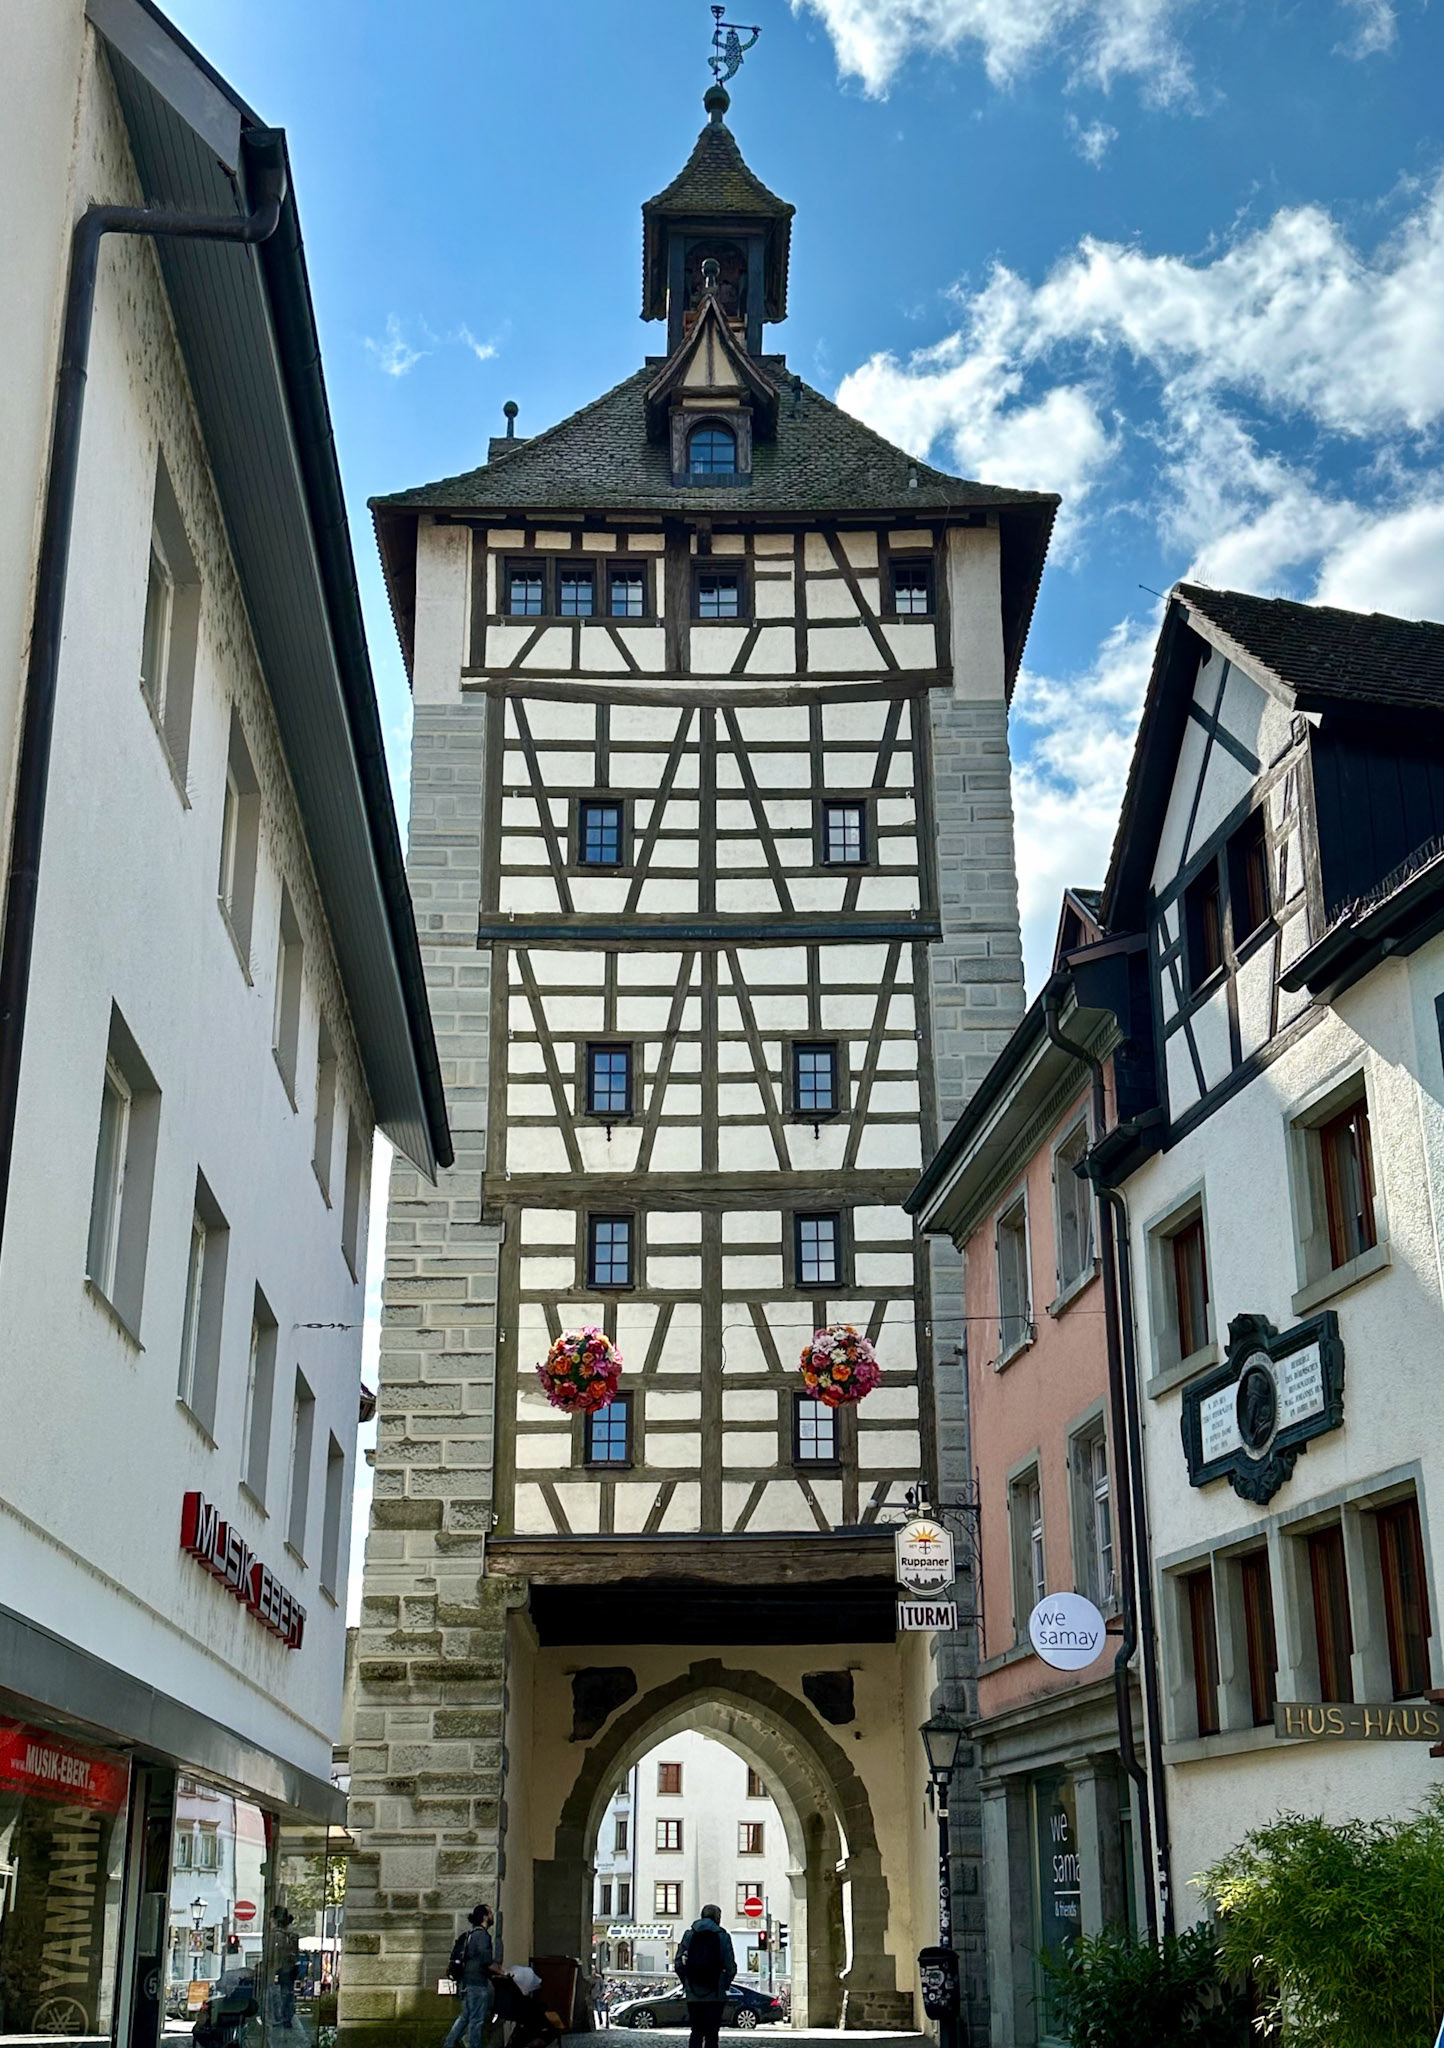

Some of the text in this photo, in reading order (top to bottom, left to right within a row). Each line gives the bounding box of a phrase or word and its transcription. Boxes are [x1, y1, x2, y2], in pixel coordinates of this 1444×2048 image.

[188, 1491, 307, 1650] MUSIK EBERT
[901, 1557, 949, 1567] Ruppaner
[905, 1606, 950, 1626] TURM
[1037, 1612, 1066, 1626] we
[1039, 1631, 1098, 1651] samay
[1050, 1813, 1068, 1842] we
[1053, 1853, 1080, 1883] sama
[40, 1806, 100, 1992] YAMAHA
